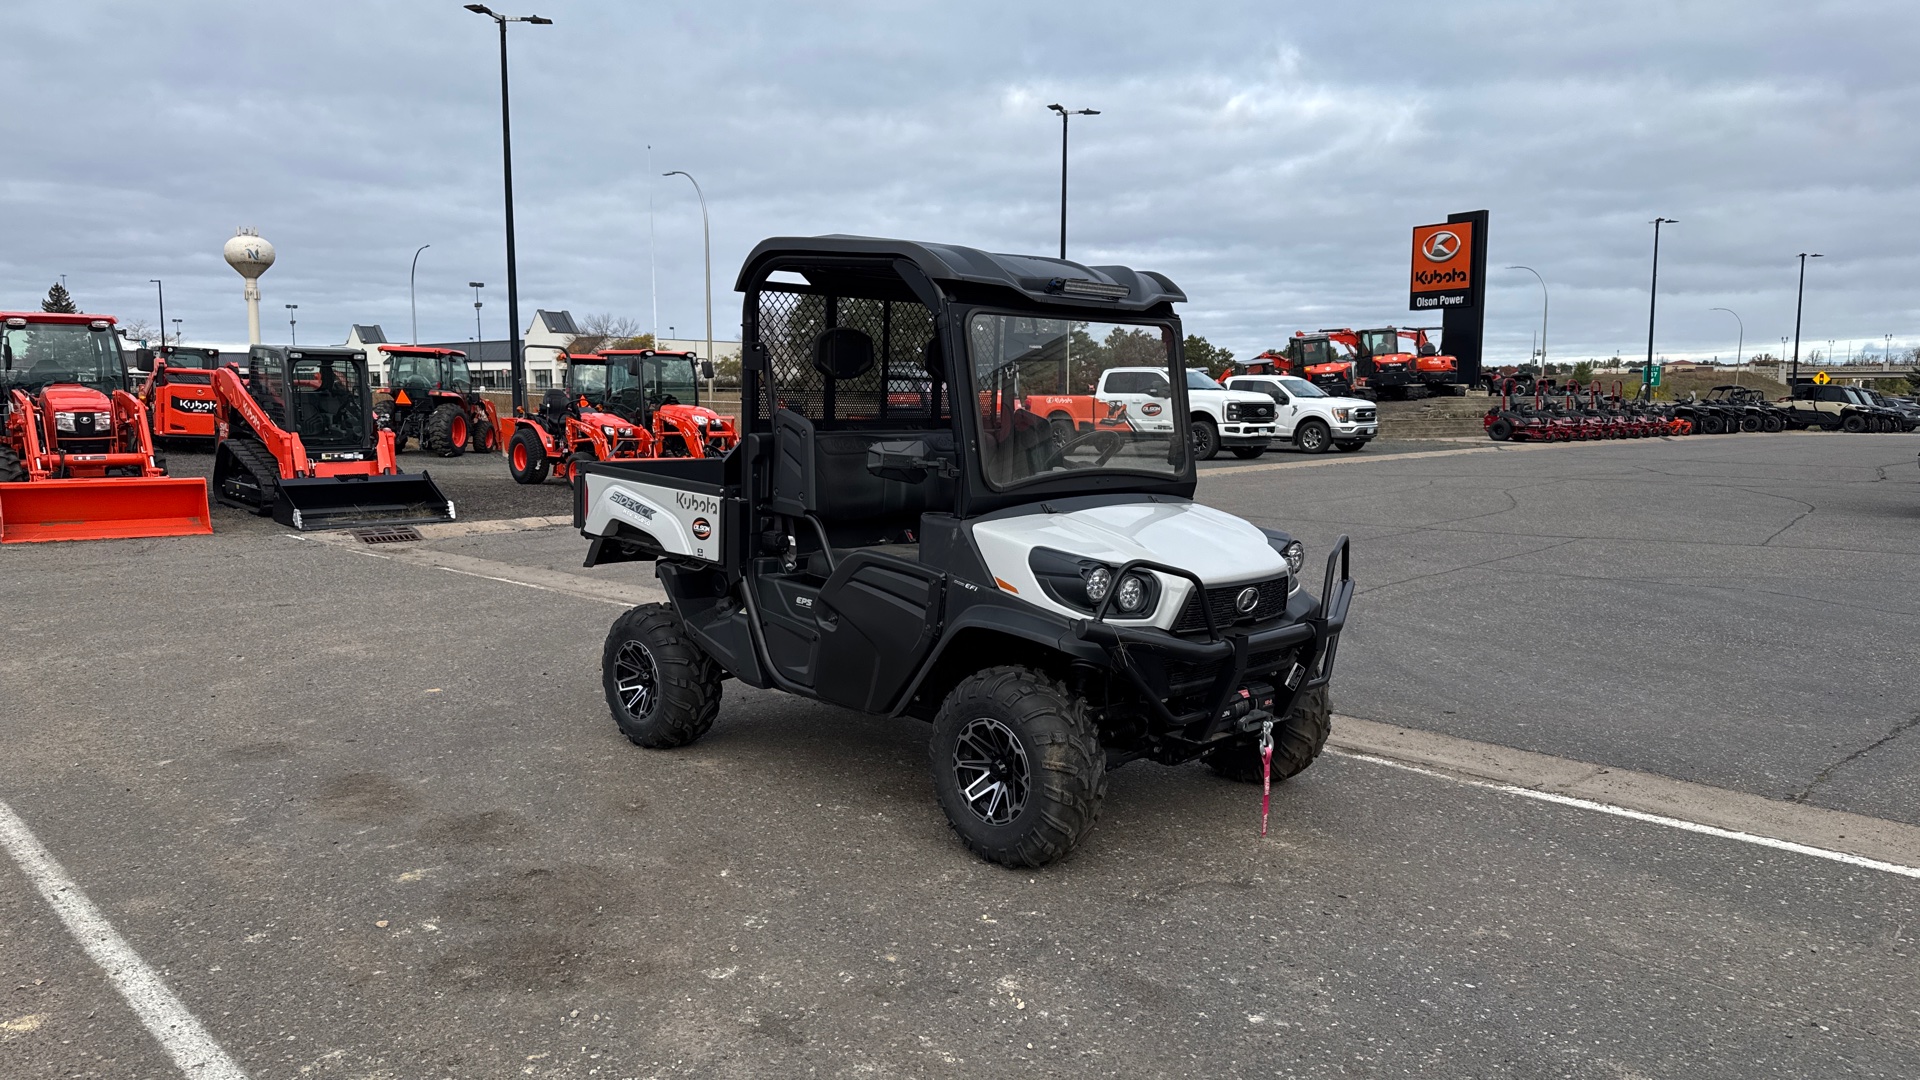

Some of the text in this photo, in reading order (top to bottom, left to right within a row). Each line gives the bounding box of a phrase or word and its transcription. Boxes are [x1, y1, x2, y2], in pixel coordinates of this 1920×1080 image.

[1415, 268, 1467, 285] Kubota
[1416, 295, 1465, 307] Olson Power
[242, 399, 261, 431] Kubota
[610, 491, 656, 521] SIDEKICK
[676, 492, 718, 515] Kubota
[693, 524, 711, 533] OLSON
[965, 583, 979, 592] EFI
[796, 596, 813, 607] EPS
